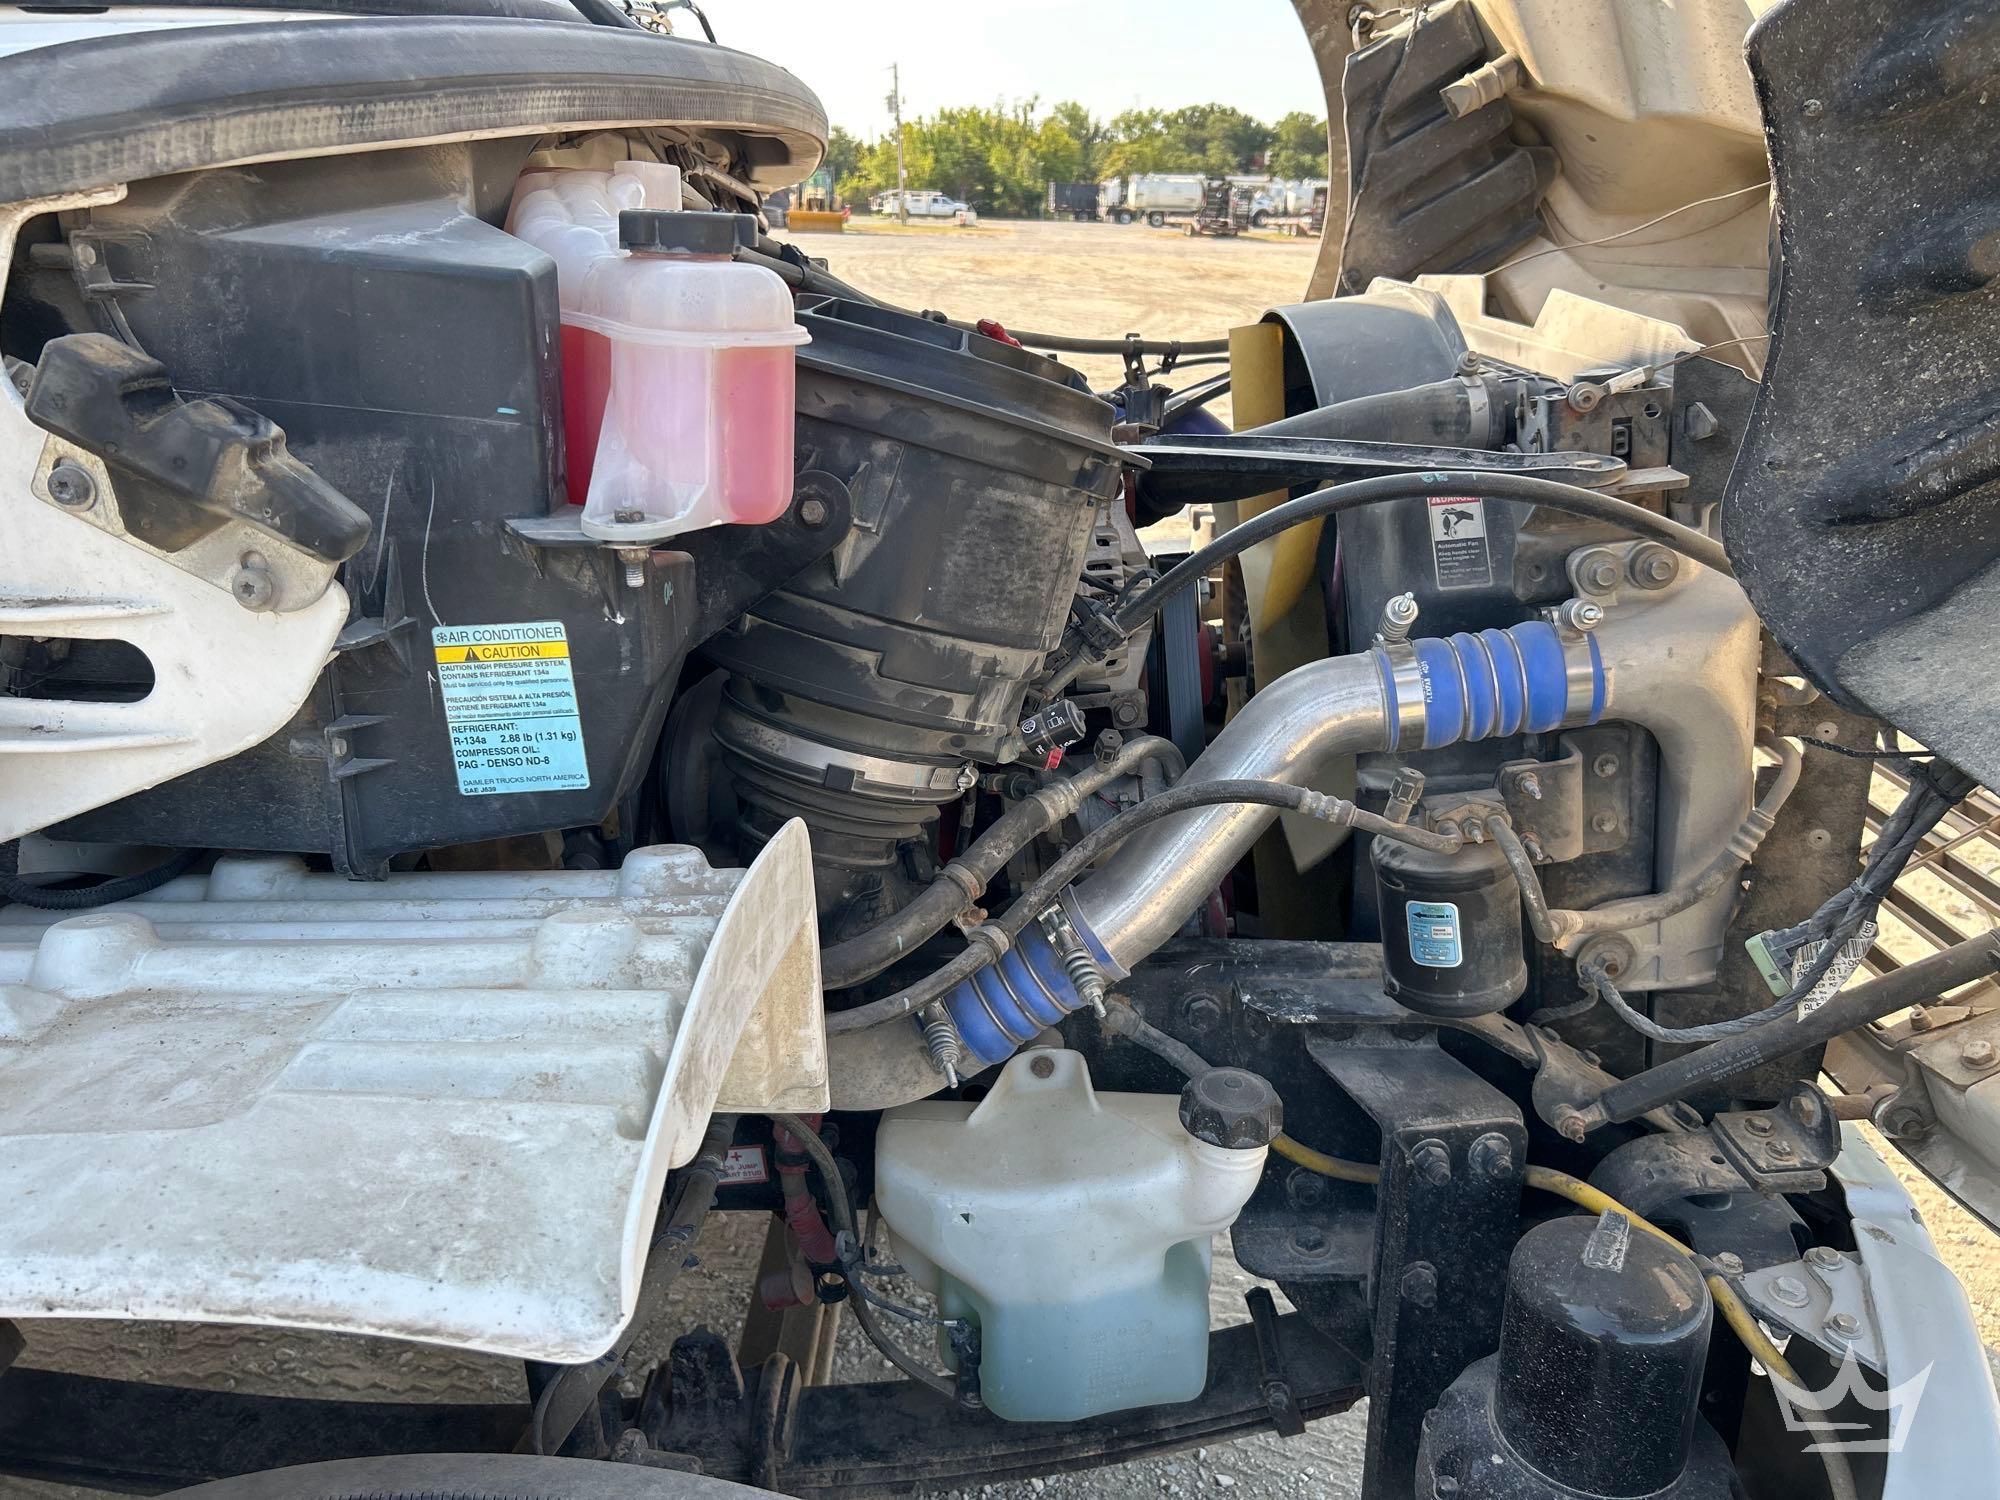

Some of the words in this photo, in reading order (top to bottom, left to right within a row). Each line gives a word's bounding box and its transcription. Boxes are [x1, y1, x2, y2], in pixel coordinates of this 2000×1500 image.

[448, 632, 470, 643] AIR
[472, 626, 563, 642] CONDITIONER
[482, 645, 540, 659] CAUTION
[440, 664, 473, 672] CAUTION
[473, 663, 493, 671] HIGH
[493, 661, 533, 669] PRESSURE
[441, 672, 479, 680] CONTAINS
[480, 669, 532, 678] REFRIGERANT
[467, 680, 491, 688] serviced
[506, 679, 514, 687] by
[514, 678, 540, 686] qualified
[445, 695, 488, 704] PRECAUCIÓN
[488, 693, 518, 701] SISTEMA
[524, 692, 541, 700] ALTA
[447, 703, 480, 712] CONTIENE
[480, 701, 531, 710] REFRIGERANTE
[531, 700, 547, 708] 134a
[451, 722, 519, 734] REFRIGERANT:
[453, 735, 487, 746] R-134a
[523, 732, 533, 742] lb
[534, 731, 558, 744] (1.31
[561, 730, 577, 742] kg)
[455, 746, 520, 758] COMPRESSOR
[521, 745, 541, 755] OIL:
[458, 760, 479, 770] PAG
[487, 757, 523, 768] DENSO
[525, 755, 551, 766] ND-8
[463, 778, 494, 787] DAIMLER
[496, 776, 525, 786] TRUCKS
[526, 775, 552, 784] NORTH
[552, 773, 585, 782] AMERICA
